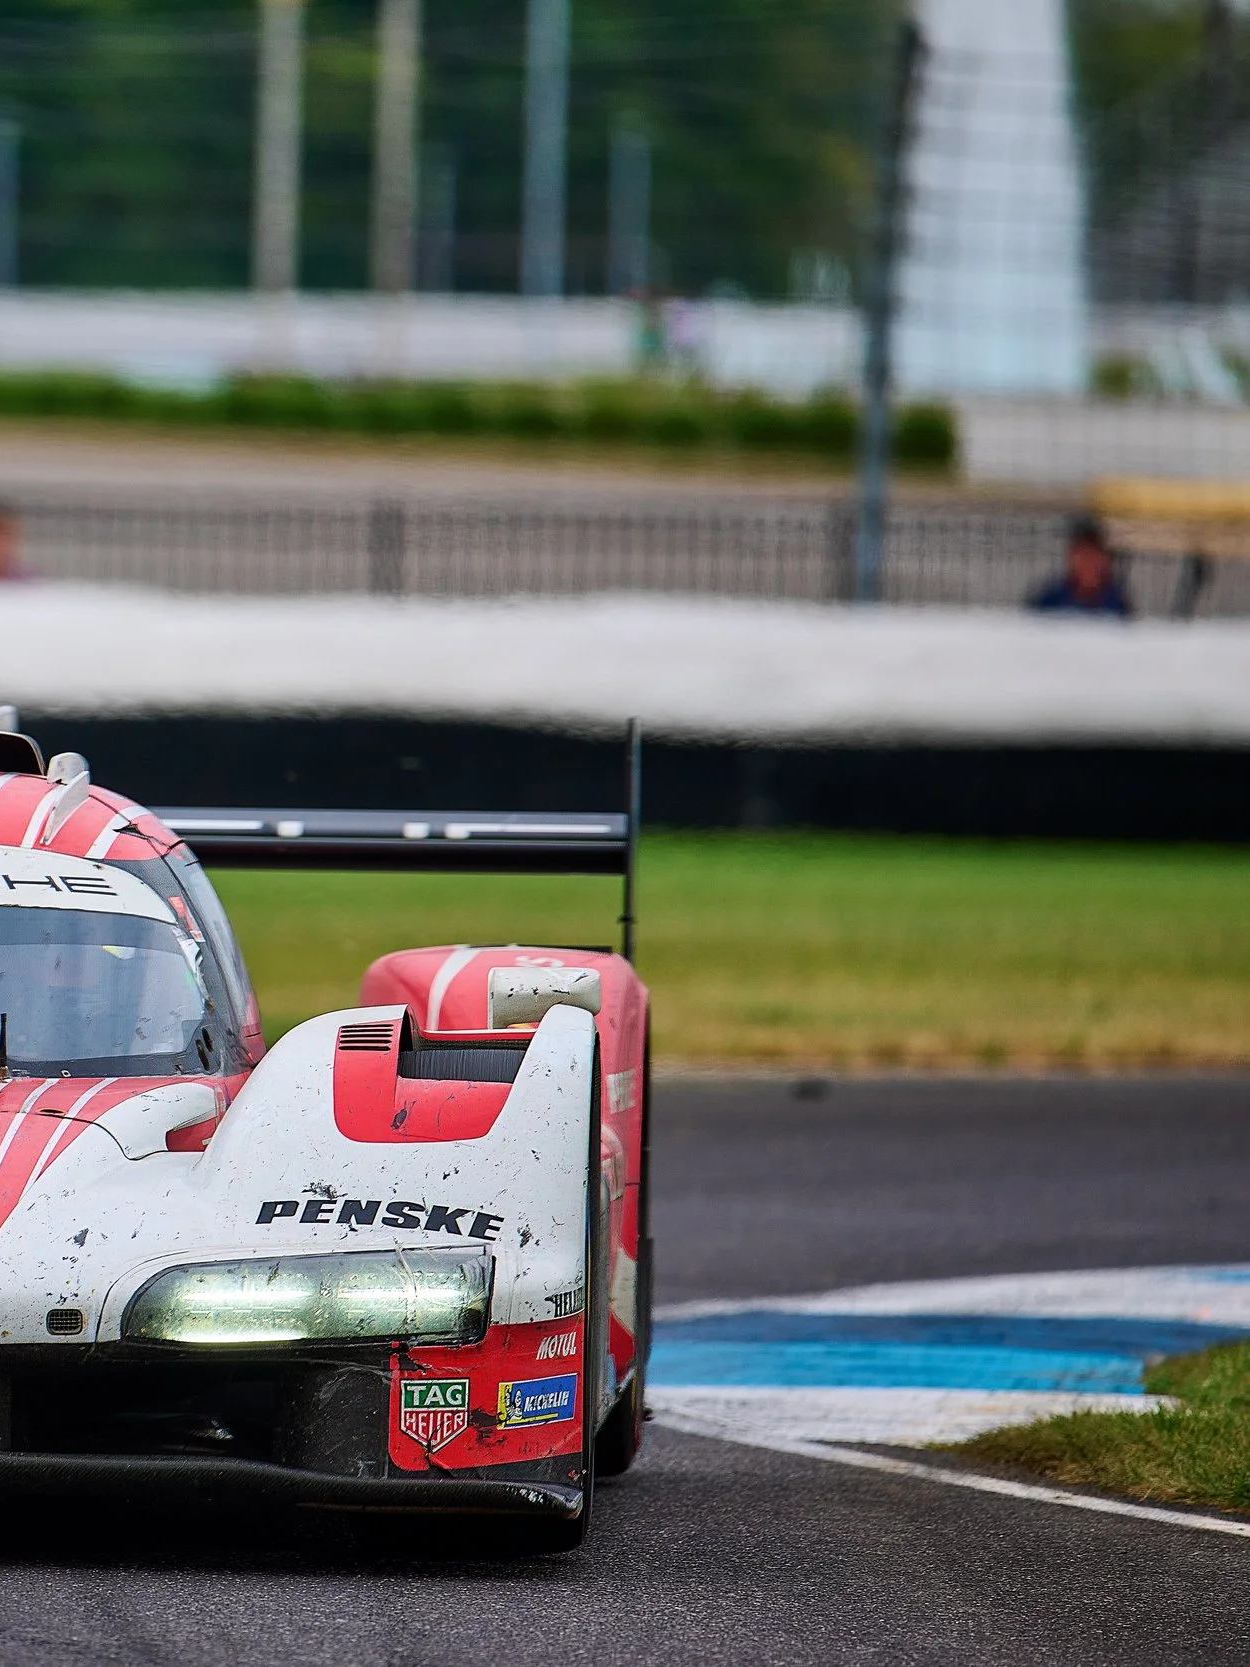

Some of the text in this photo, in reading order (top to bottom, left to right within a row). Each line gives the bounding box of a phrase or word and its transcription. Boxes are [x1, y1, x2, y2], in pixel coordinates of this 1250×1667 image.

[255, 1199, 505, 1241] PENSKE
[536, 1332, 577, 1361] MOTUL
[406, 1384, 463, 1406] TAG
[523, 1390, 570, 1413] MICHELIN
[405, 1411, 464, 1444] HEUER
